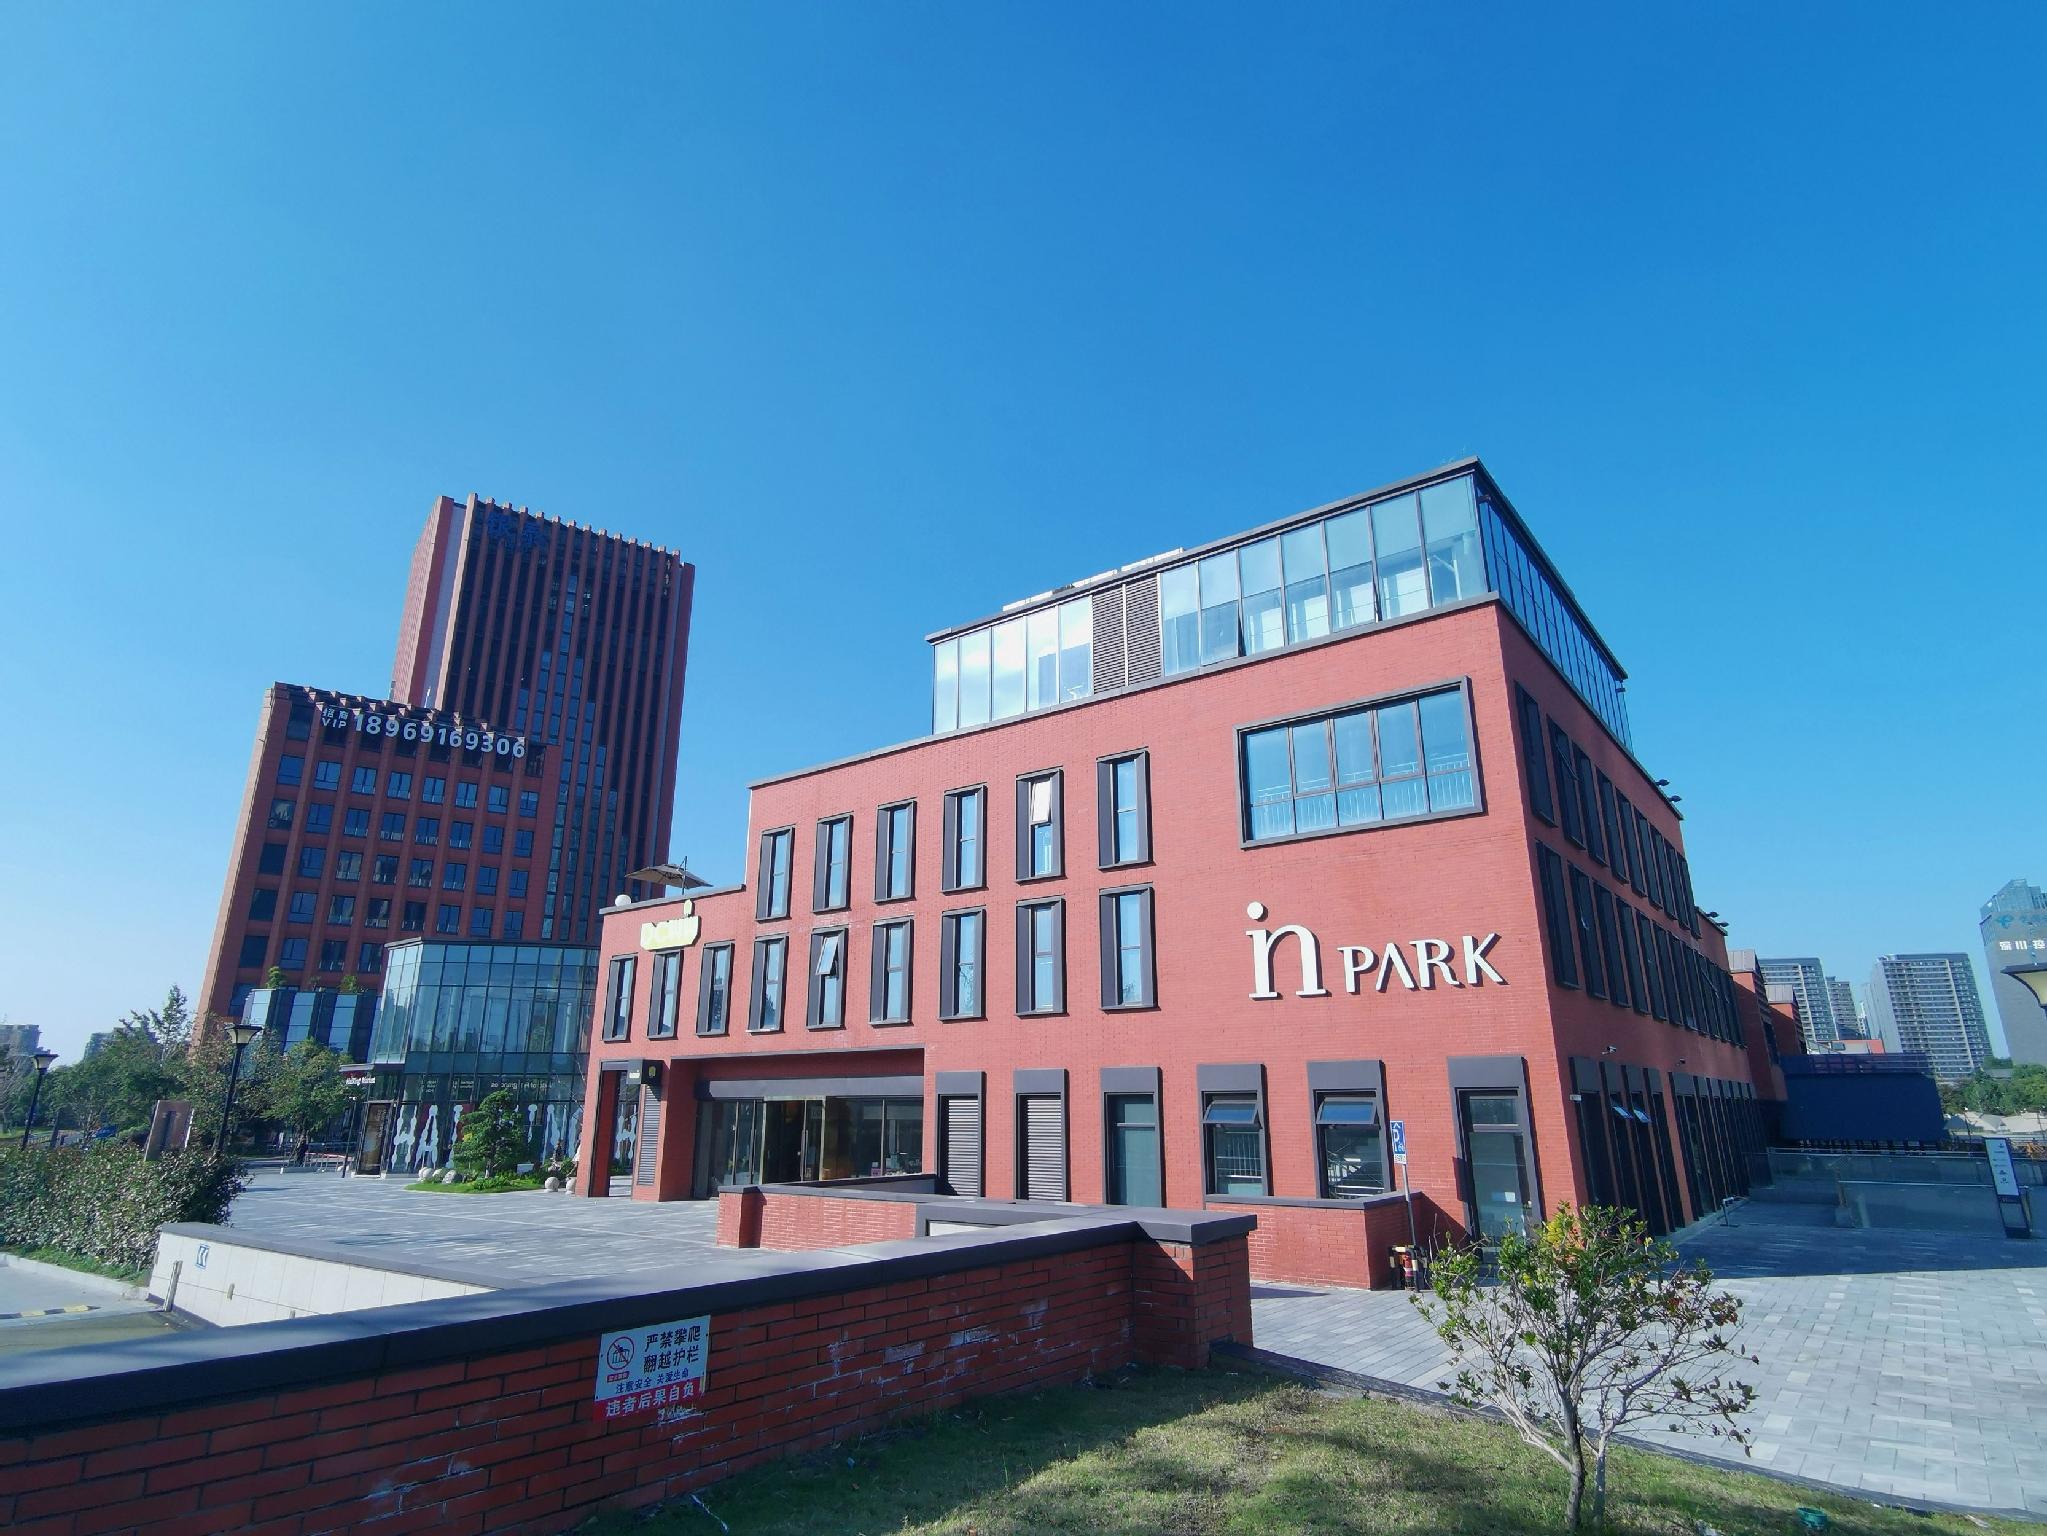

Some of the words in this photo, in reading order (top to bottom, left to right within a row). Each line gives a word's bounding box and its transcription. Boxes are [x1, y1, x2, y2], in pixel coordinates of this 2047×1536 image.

[322, 717, 347, 728] VIP
[354, 713, 526, 759] 18969169306
[1245, 901, 1327, 998] in
[1336, 932, 1504, 993] PARK
[645, 1325, 701, 1352] 严禁攀爬
[643, 1344, 699, 1373] 翻越护栏
[615, 1376, 652, 1394] 注意安全
[656, 1367, 689, 1385] 关爱生命
[606, 1381, 694, 1417] 违者后果自负
